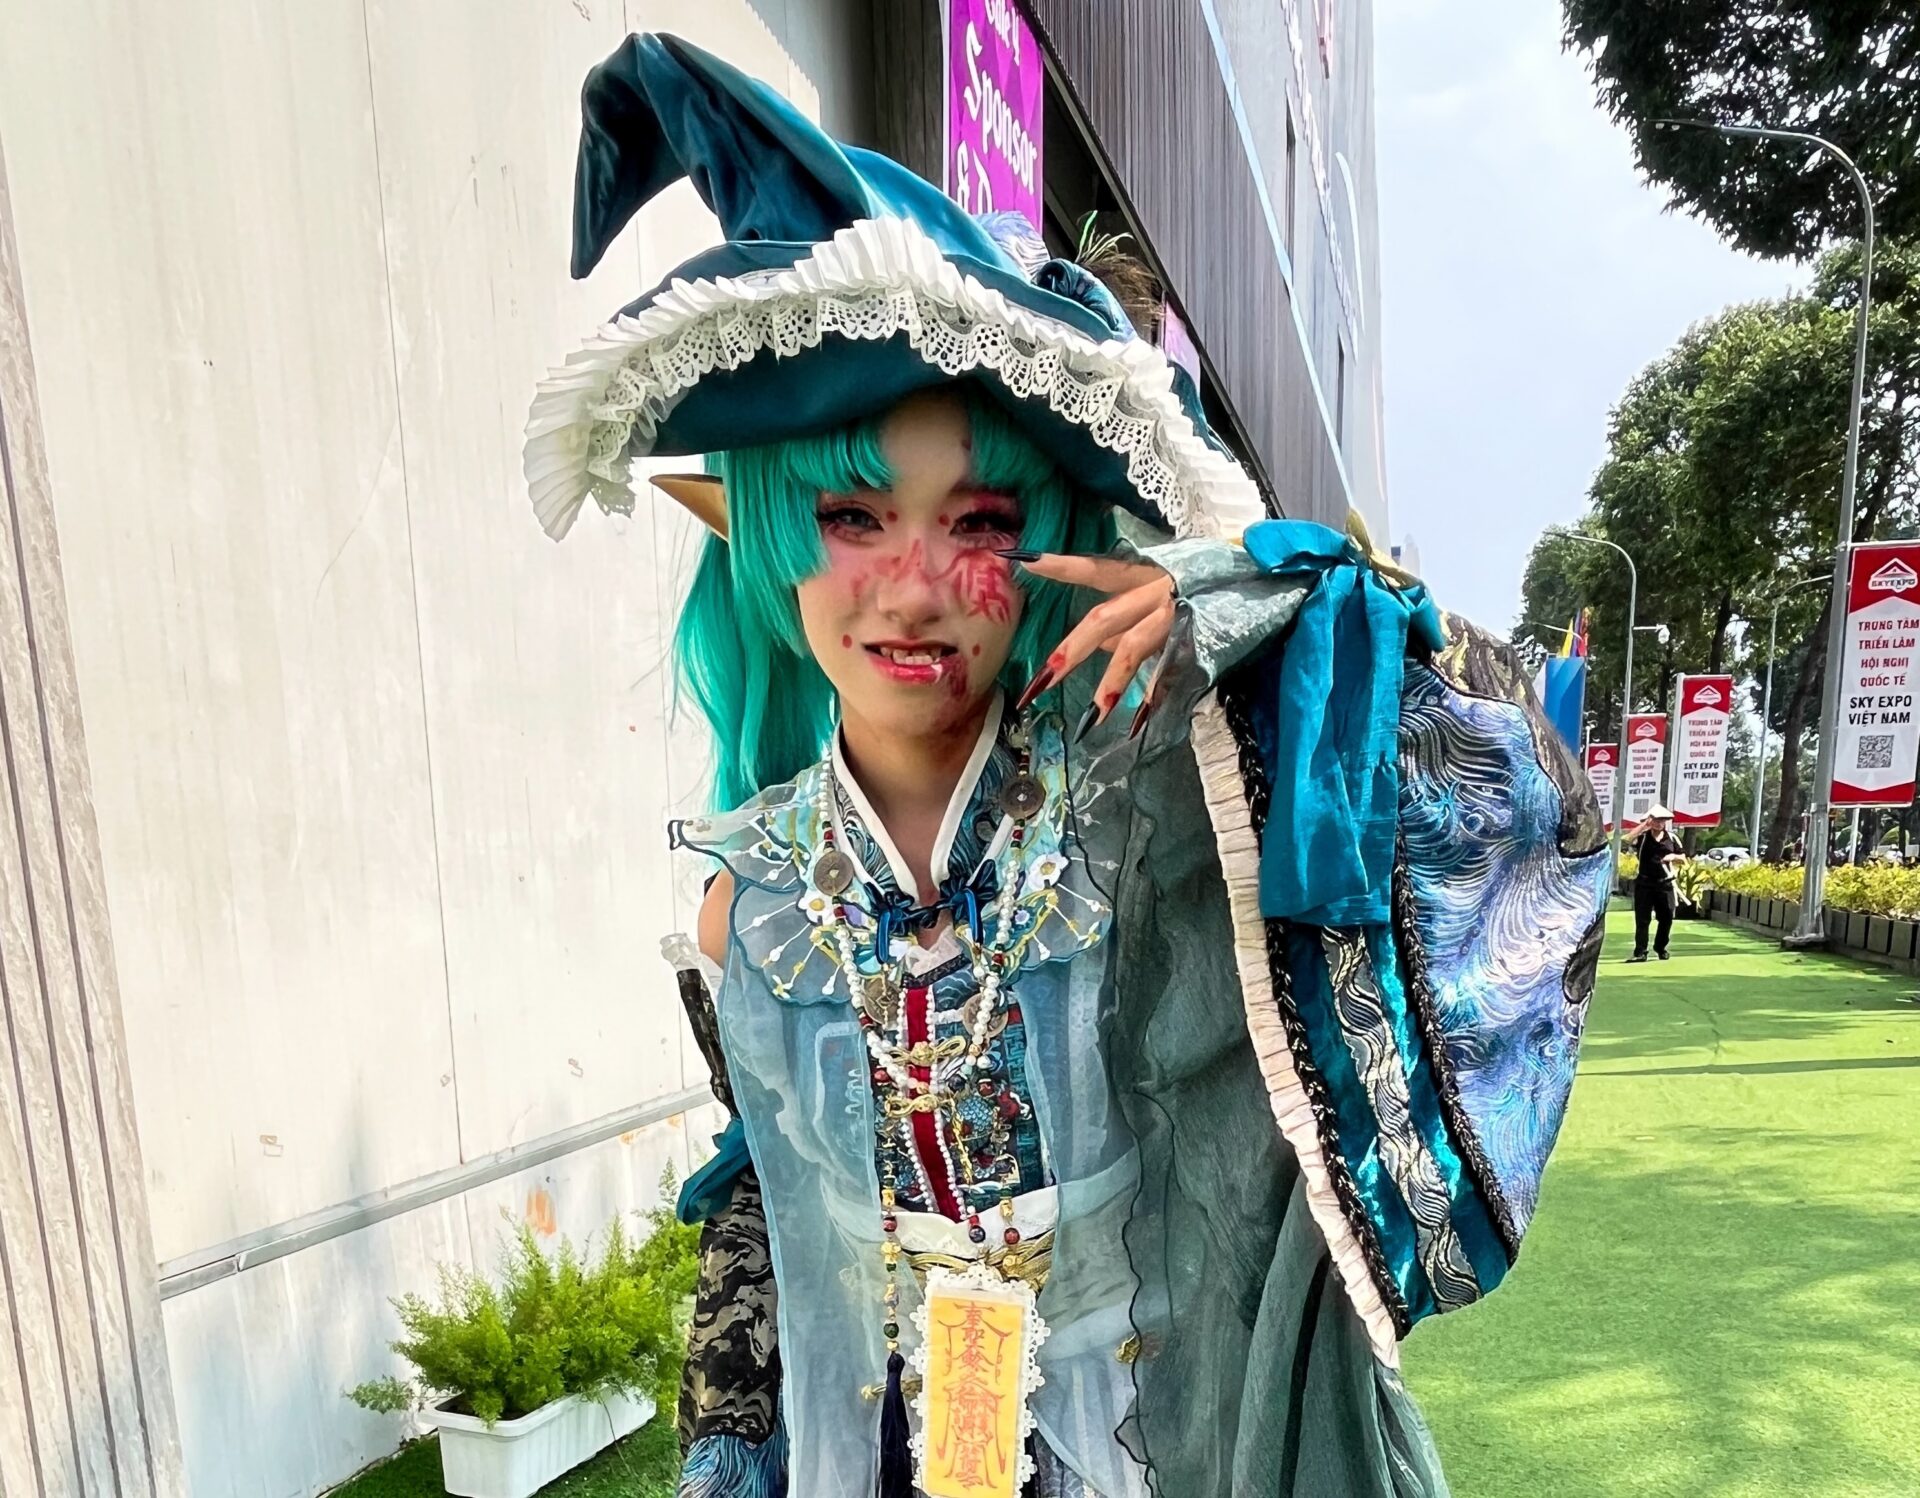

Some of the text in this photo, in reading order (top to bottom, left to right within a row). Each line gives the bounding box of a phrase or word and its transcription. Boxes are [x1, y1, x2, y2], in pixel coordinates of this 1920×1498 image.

[963, 20, 1038, 196] Sponsor
[1858, 617, 1920, 631] TRUNG TÂM
[1860, 656, 1880, 670] HỘI
[1860, 672, 1908, 687] QUỐC TẾ
[1850, 695, 1912, 708] SKY EXPO
[1848, 710, 1911, 727] VIỆT NAM
